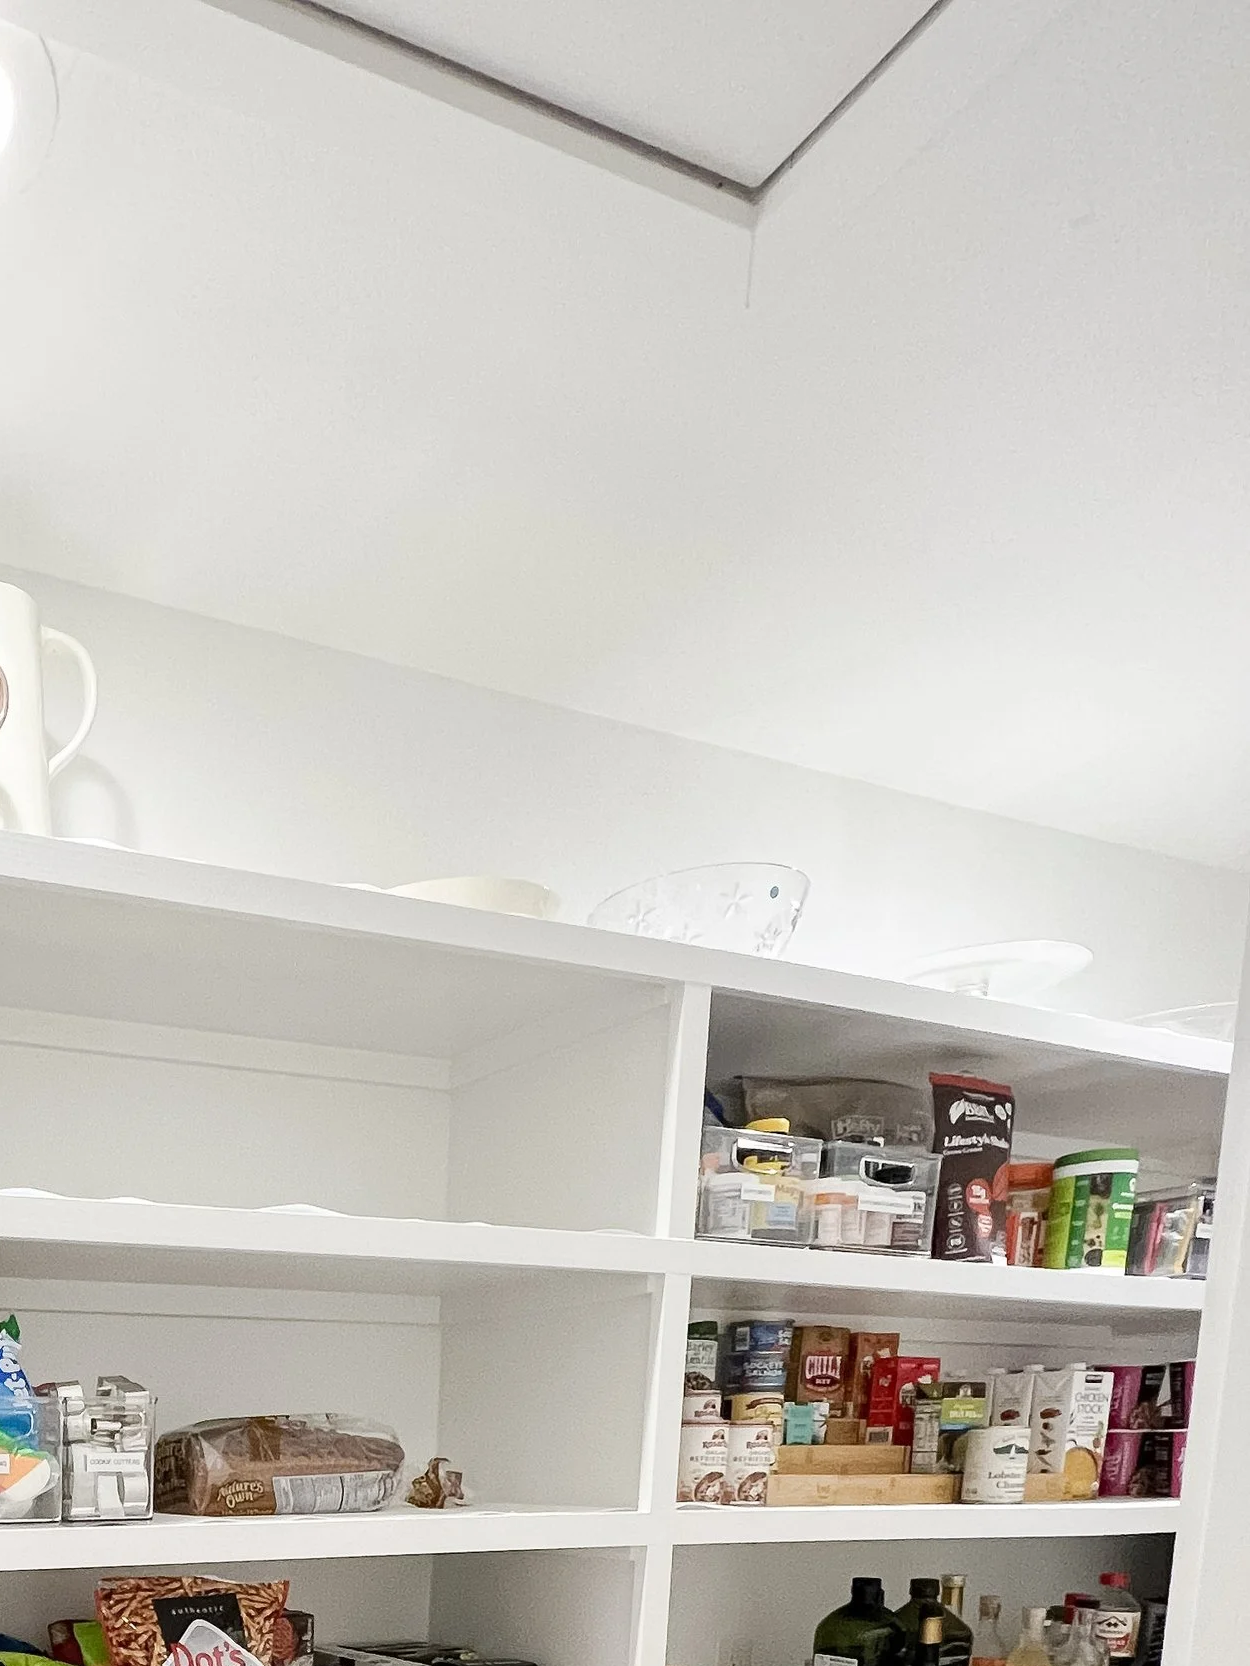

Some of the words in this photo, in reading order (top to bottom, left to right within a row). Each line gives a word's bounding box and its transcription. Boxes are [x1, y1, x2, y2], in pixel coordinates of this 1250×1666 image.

[805, 1355, 842, 1380] CHILI
[225, 1491, 254, 1509] Own
[171, 1604, 225, 1616] authentic
